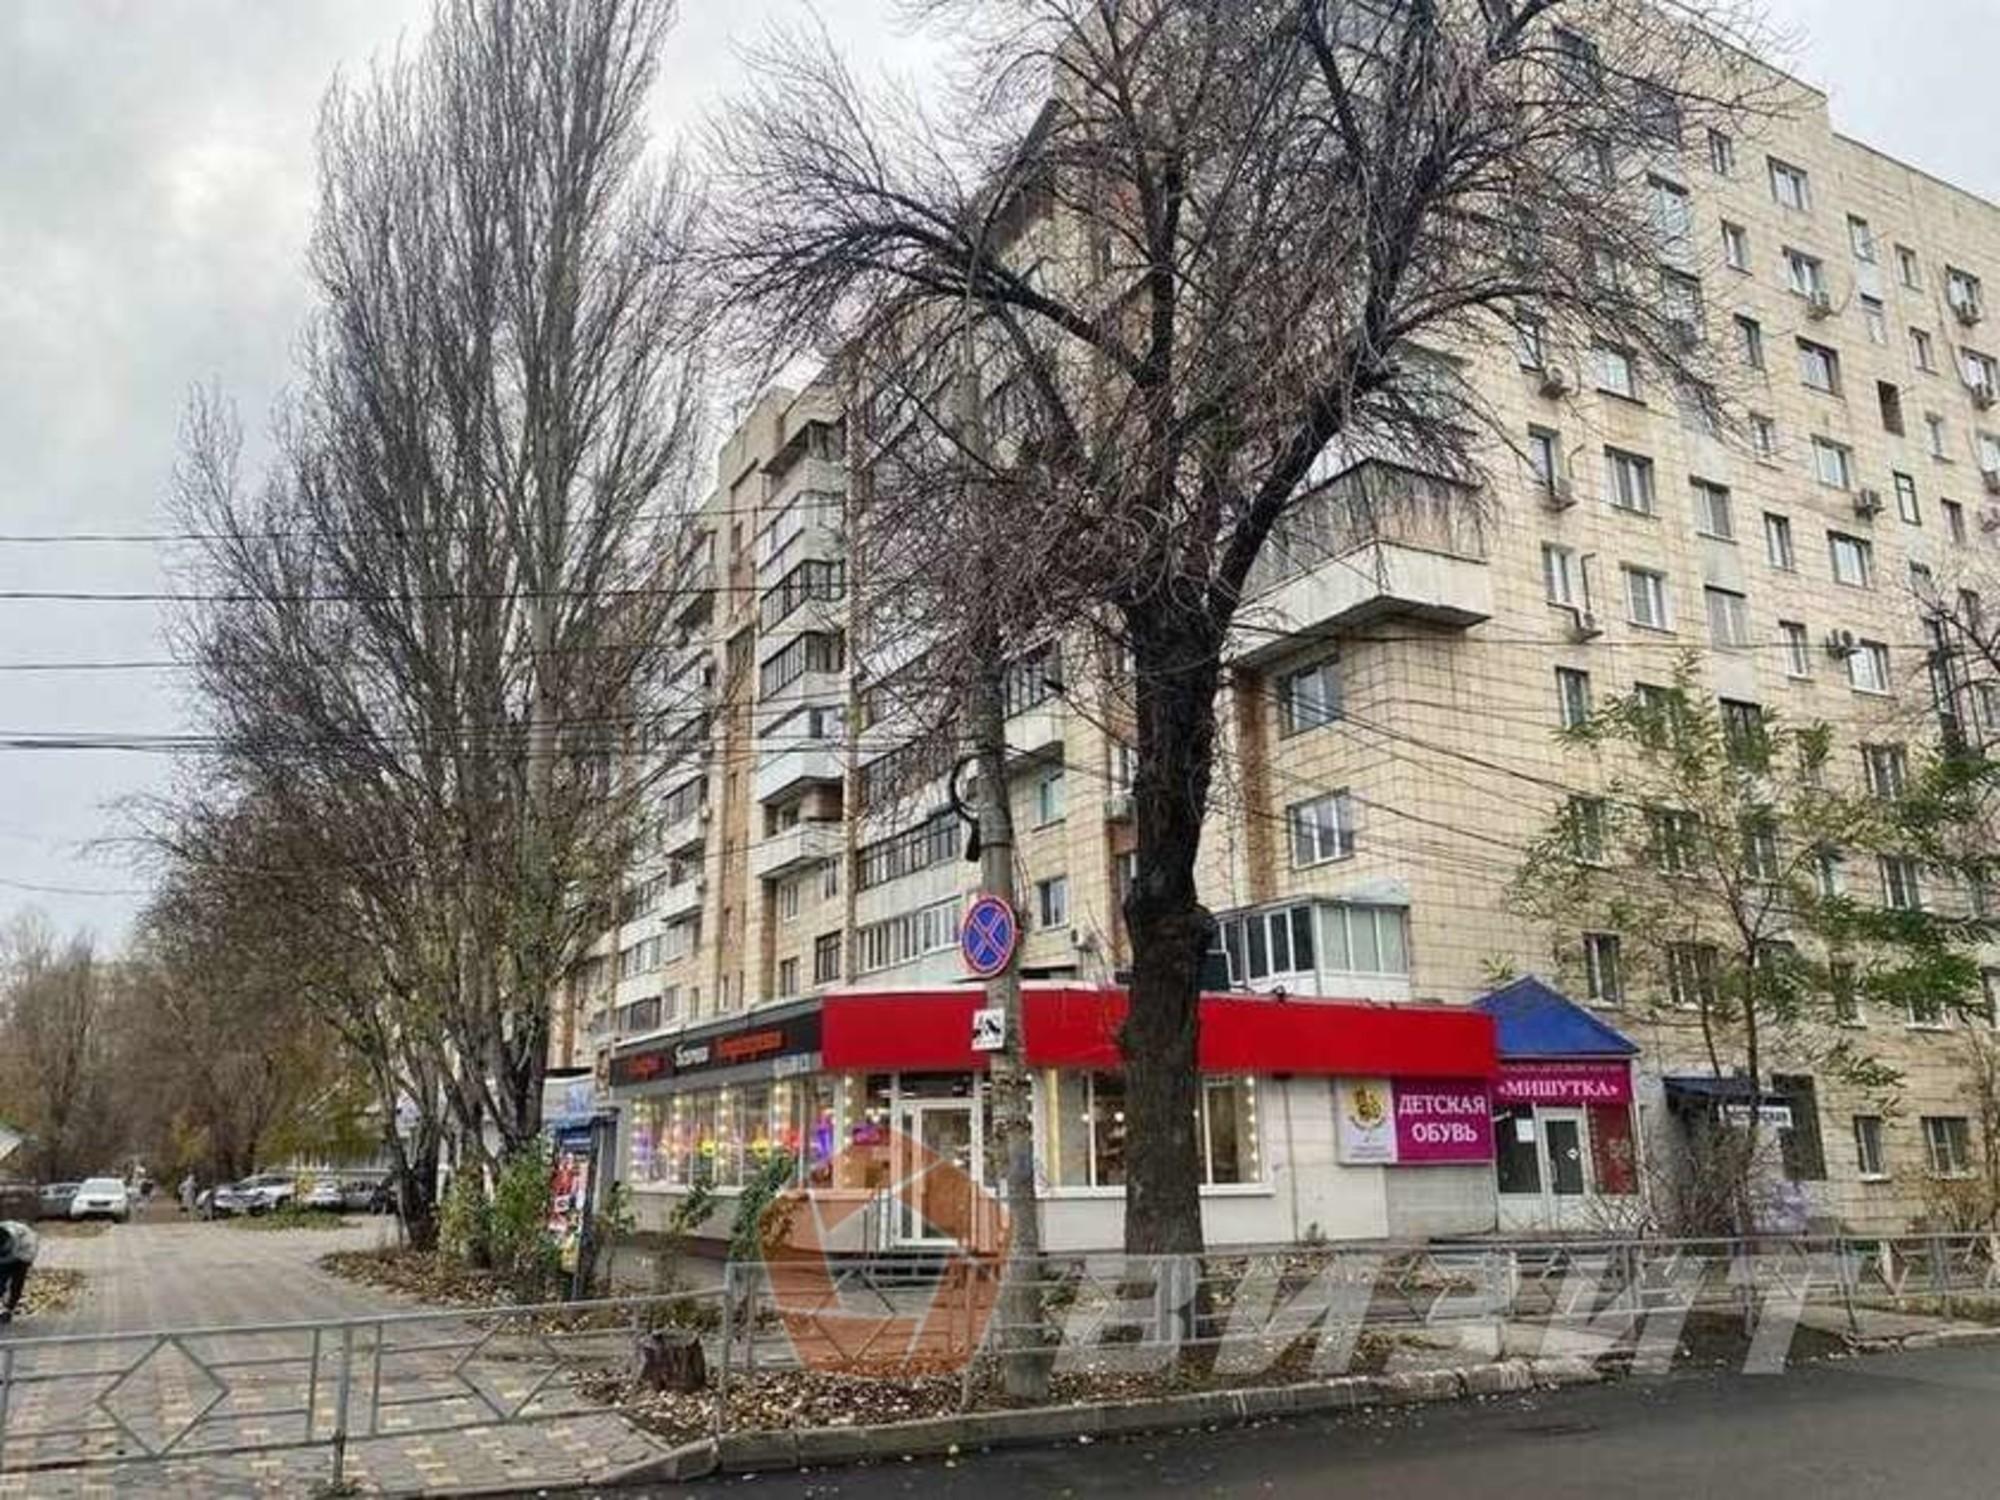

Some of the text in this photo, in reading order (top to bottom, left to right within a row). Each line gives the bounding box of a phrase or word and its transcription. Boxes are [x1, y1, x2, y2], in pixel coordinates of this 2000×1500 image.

[1499, 1080, 1619, 1096] «МИШУТКА»
[1398, 1094, 1487, 1117] ДЕТСКАЯ
[1411, 1123, 1478, 1143] ОБУВЬ
